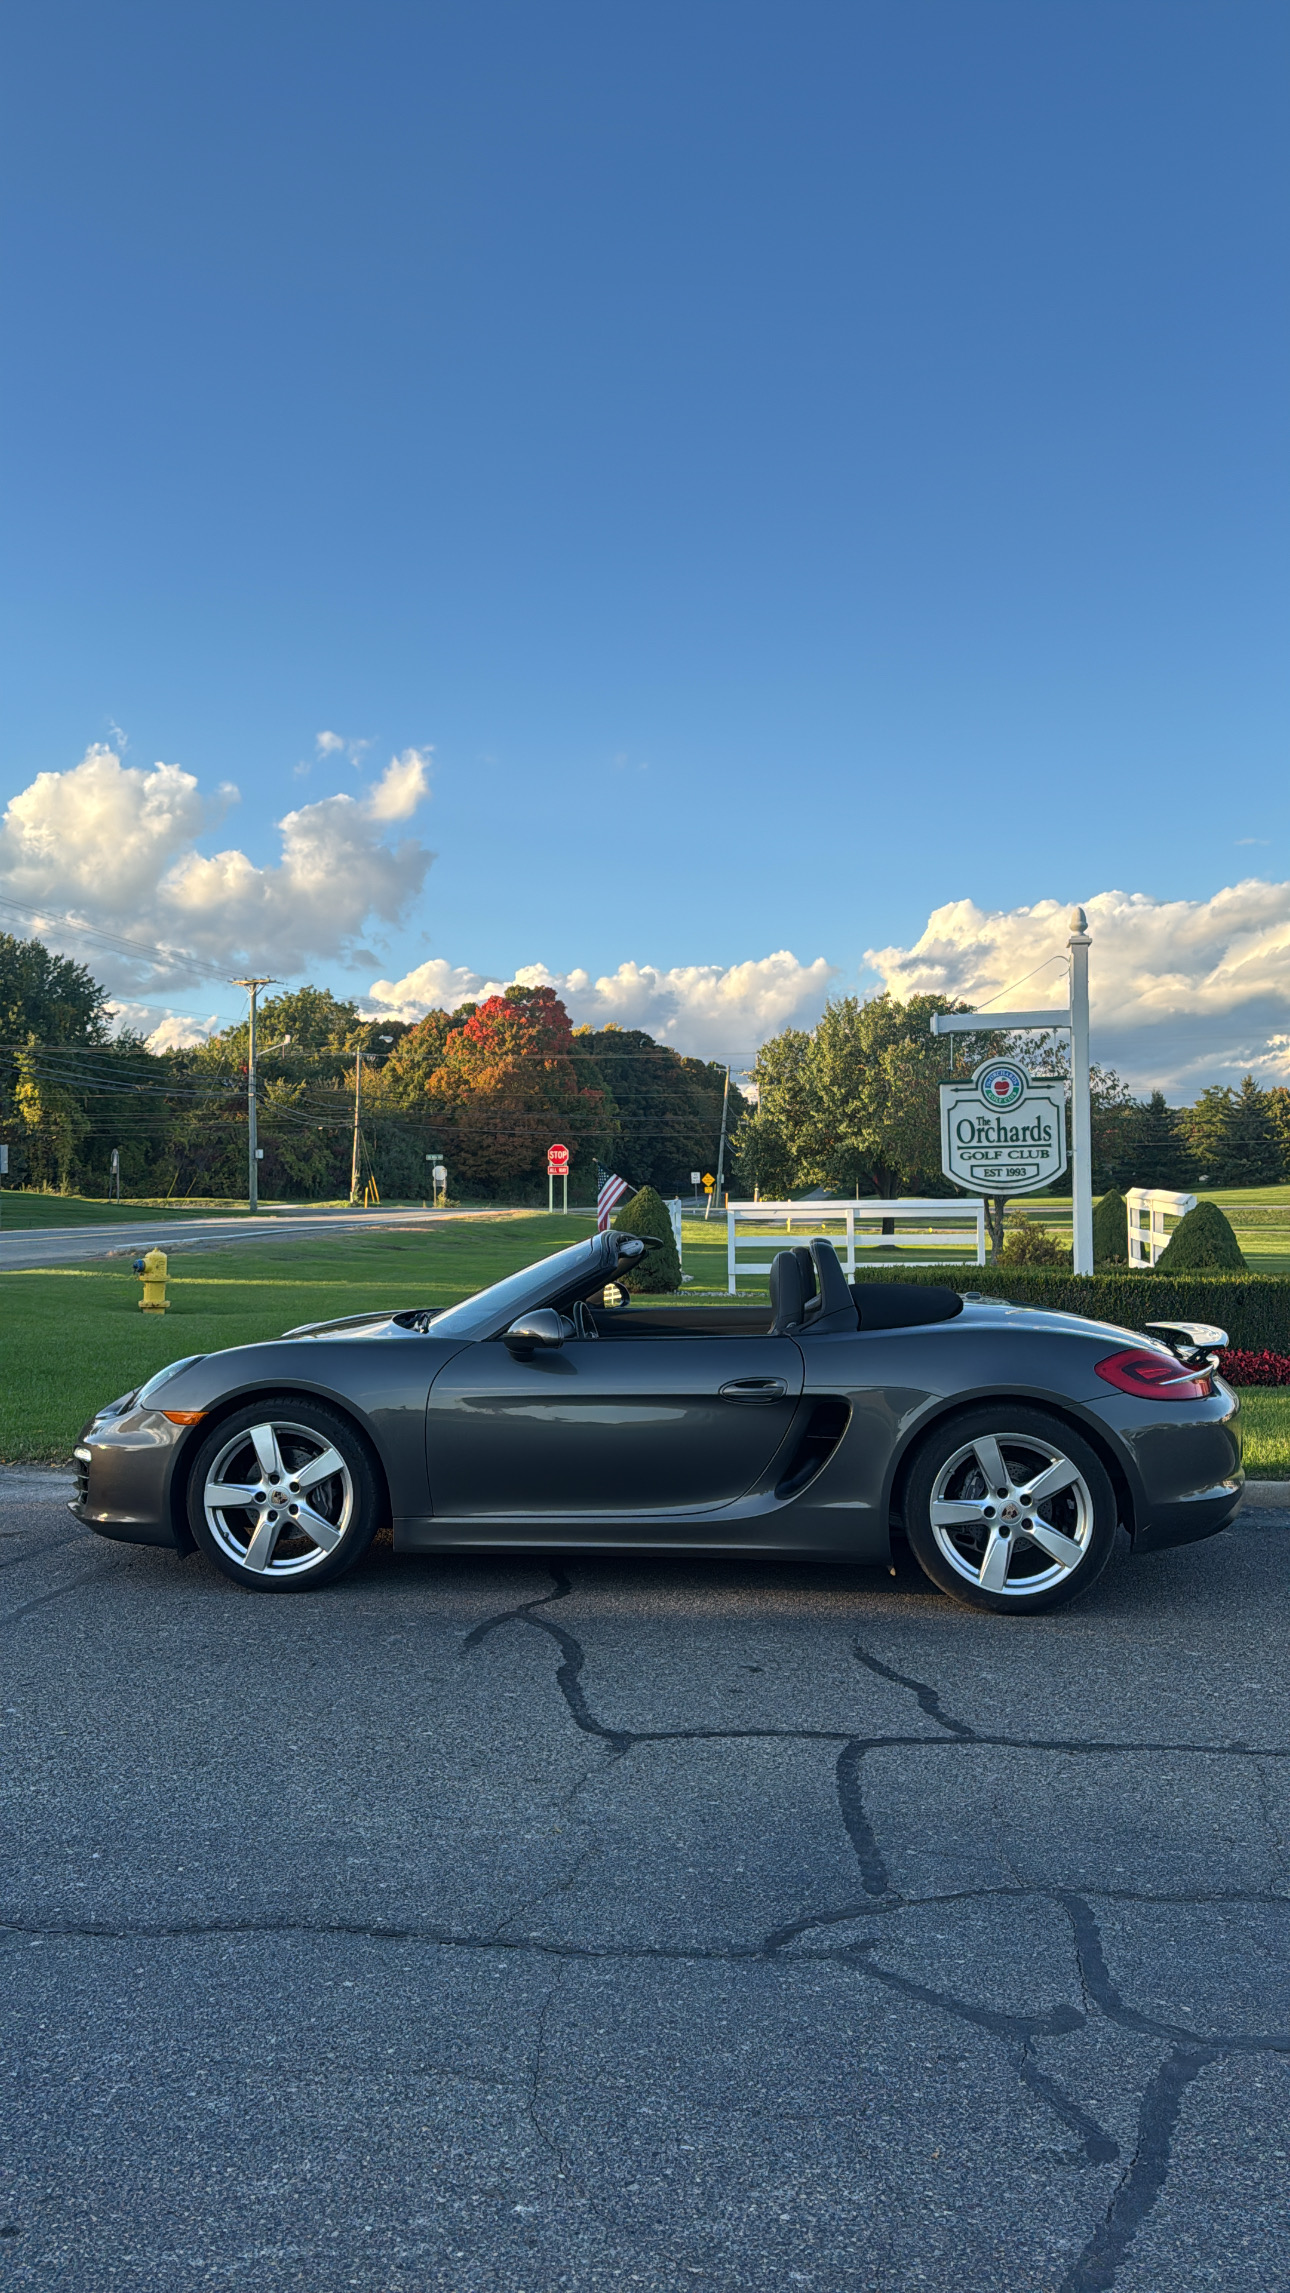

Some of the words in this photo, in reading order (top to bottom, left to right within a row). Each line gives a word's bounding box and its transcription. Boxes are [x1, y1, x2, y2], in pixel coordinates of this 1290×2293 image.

[988, 1092, 1001, 1102] GOLF
[1004, 1092, 1016, 1102] CLUB
[976, 1116, 991, 1126] The
[956, 1115, 1052, 1144] Orchards
[549, 1150, 567, 1159] STOP
[959, 1151, 1003, 1160] GOLF
[1007, 1150, 1050, 1159] CLUB
[983, 1168, 1003, 1177] EST
[1006, 1167, 1027, 1177] 1993
